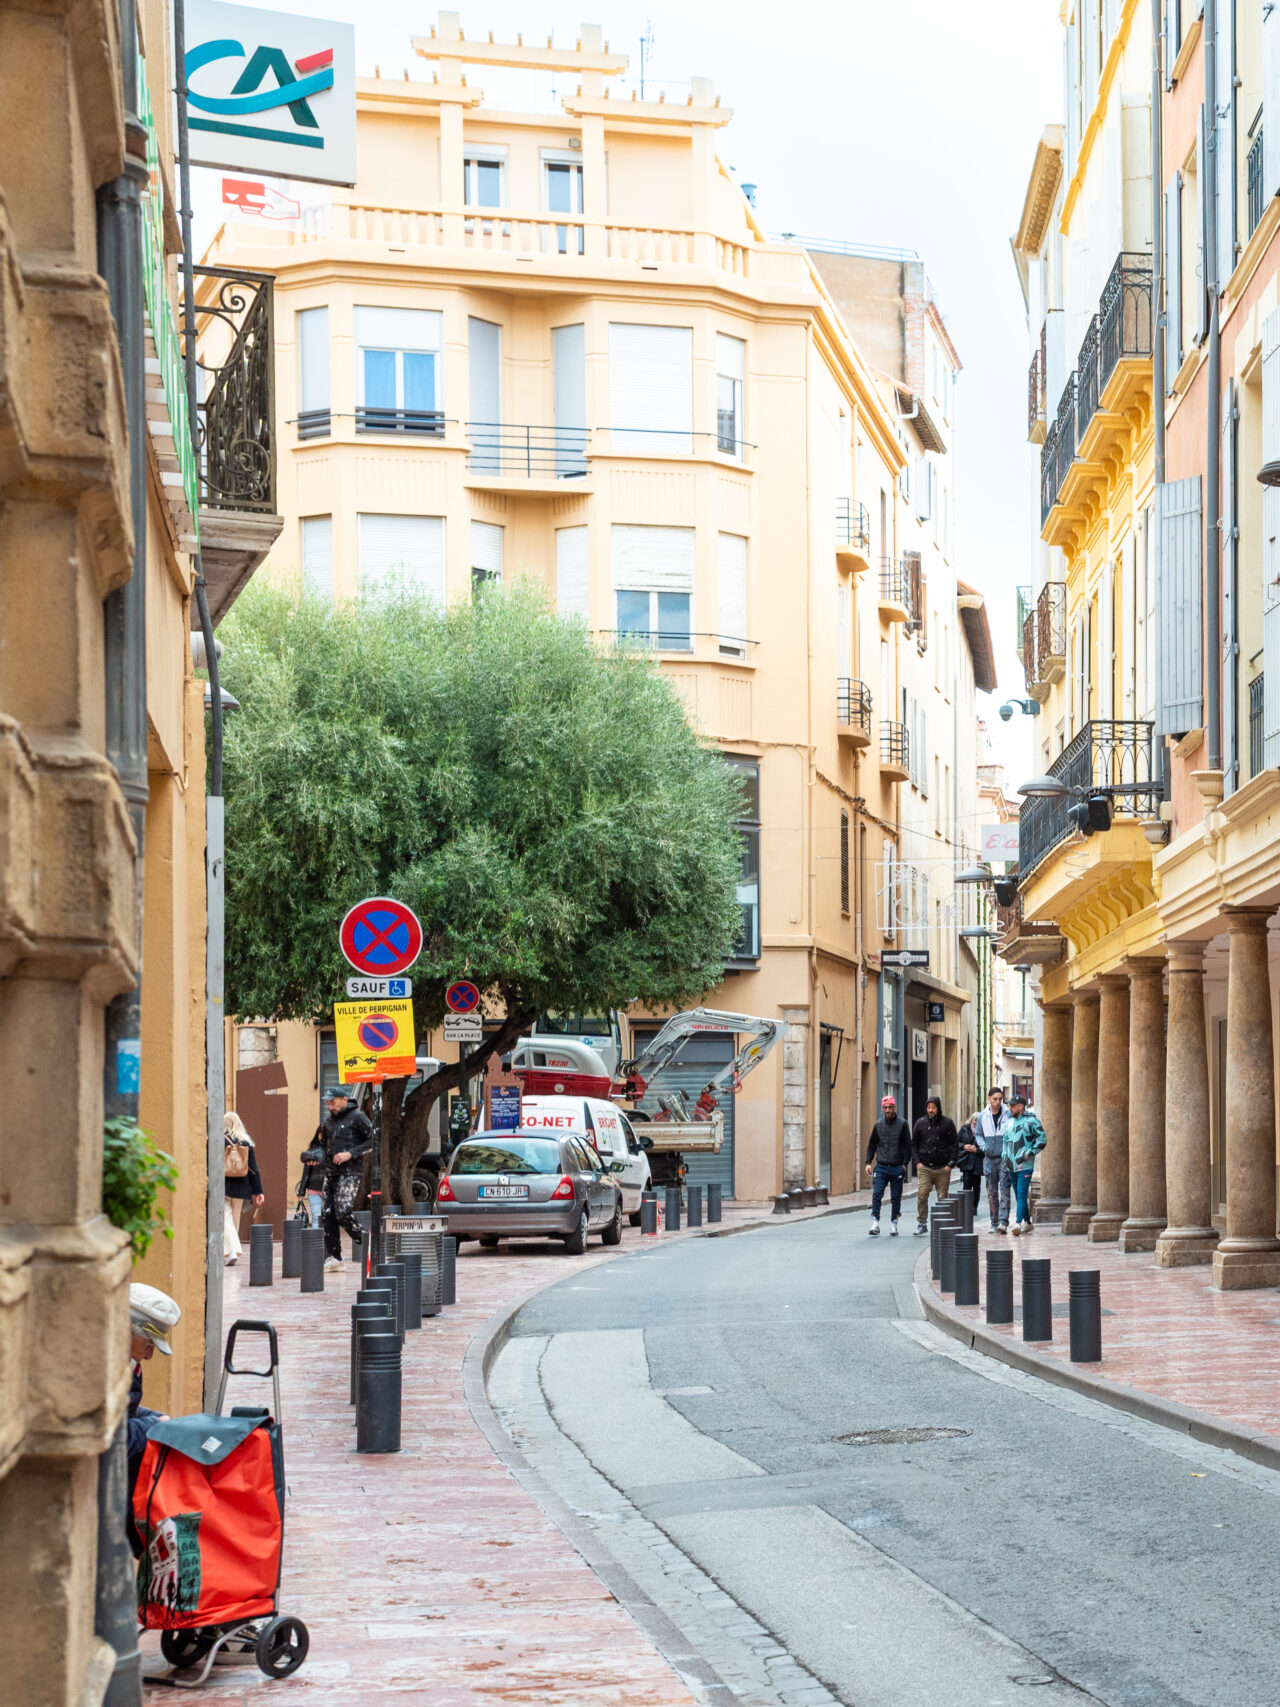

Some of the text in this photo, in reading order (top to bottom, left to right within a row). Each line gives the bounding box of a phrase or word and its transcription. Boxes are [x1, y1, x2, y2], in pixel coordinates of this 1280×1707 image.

[351, 982, 387, 994] SAUF
[337, 1003, 408, 1016] VILLE DE PERPIGNAN
